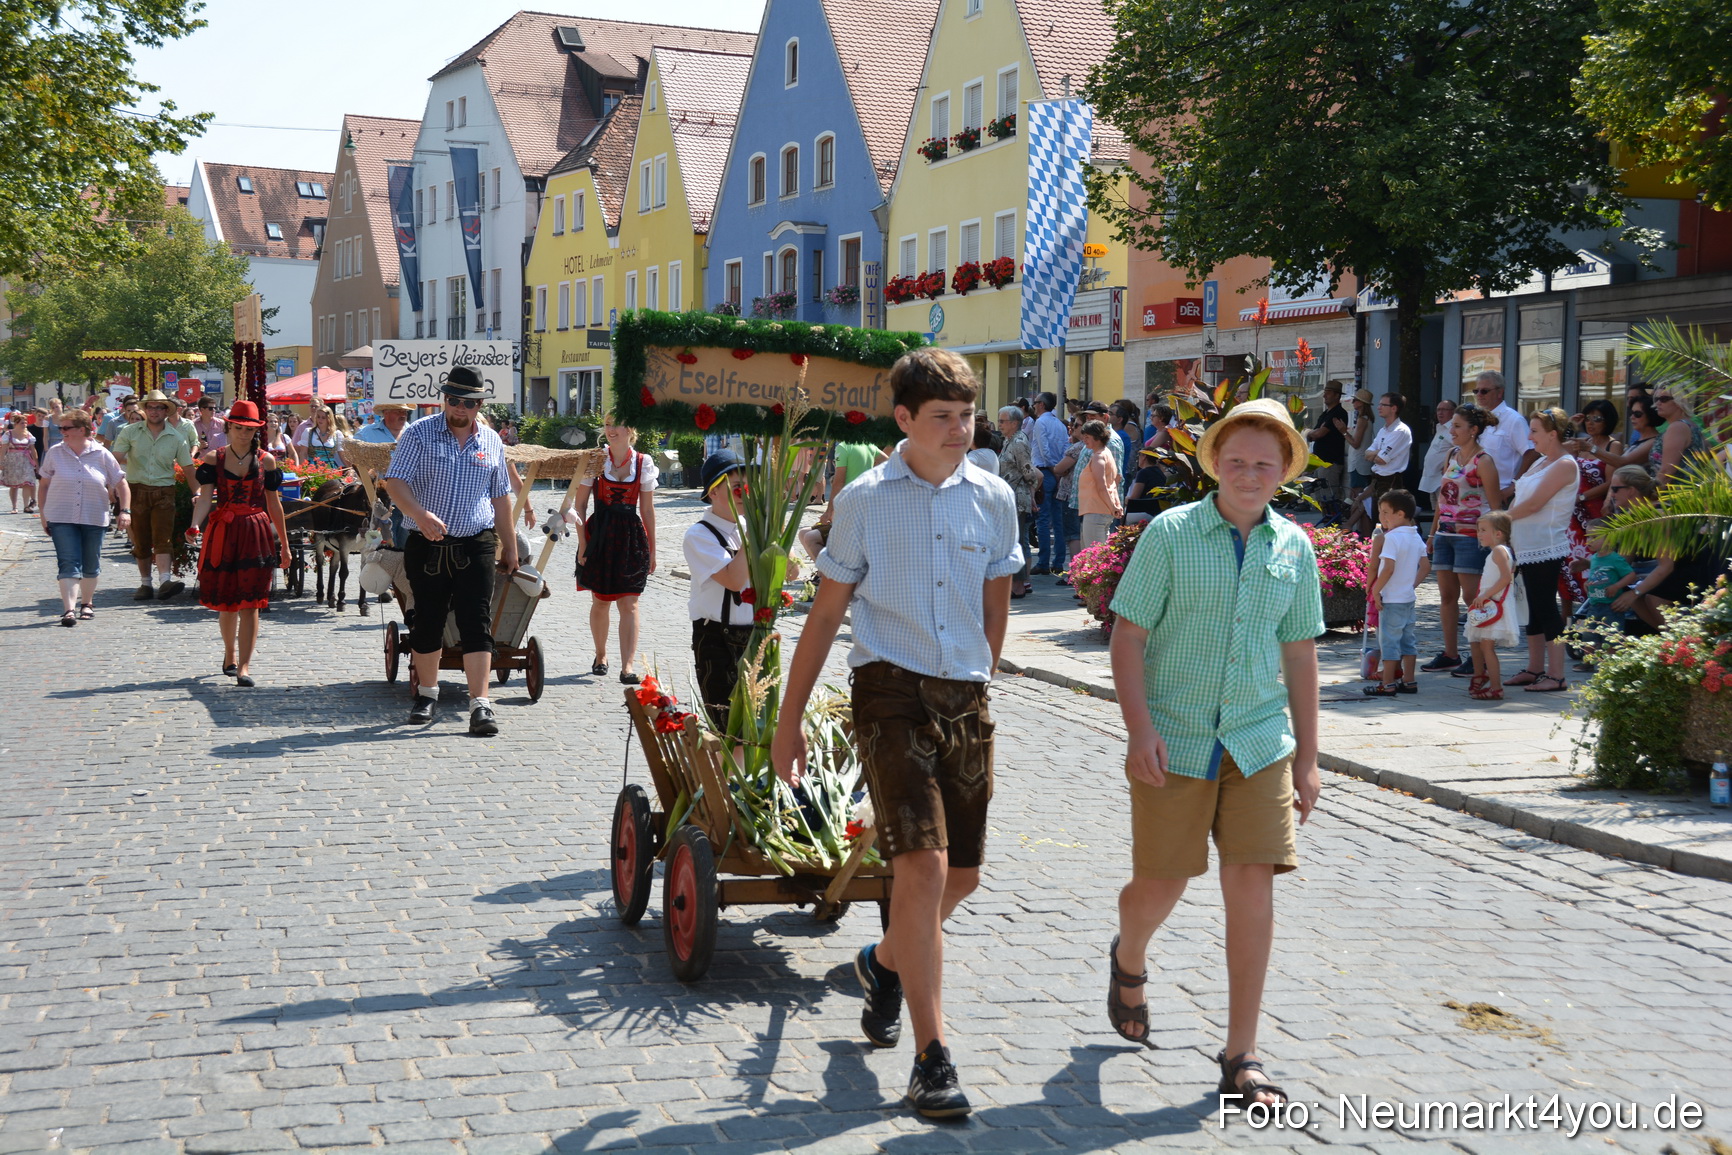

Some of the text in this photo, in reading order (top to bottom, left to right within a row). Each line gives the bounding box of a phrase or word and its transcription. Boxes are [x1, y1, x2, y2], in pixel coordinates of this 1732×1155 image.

[564, 254, 585, 275] HOTEL
[865, 277, 878, 327] WITT
[1180, 305, 1201, 317] DER
[1206, 286, 1215, 318] P
[1112, 290, 1121, 346] KINO
[1143, 314, 1156, 327] DER
[451, 344, 511, 367] kleinster
[561, 350, 591, 364] Restaurant
